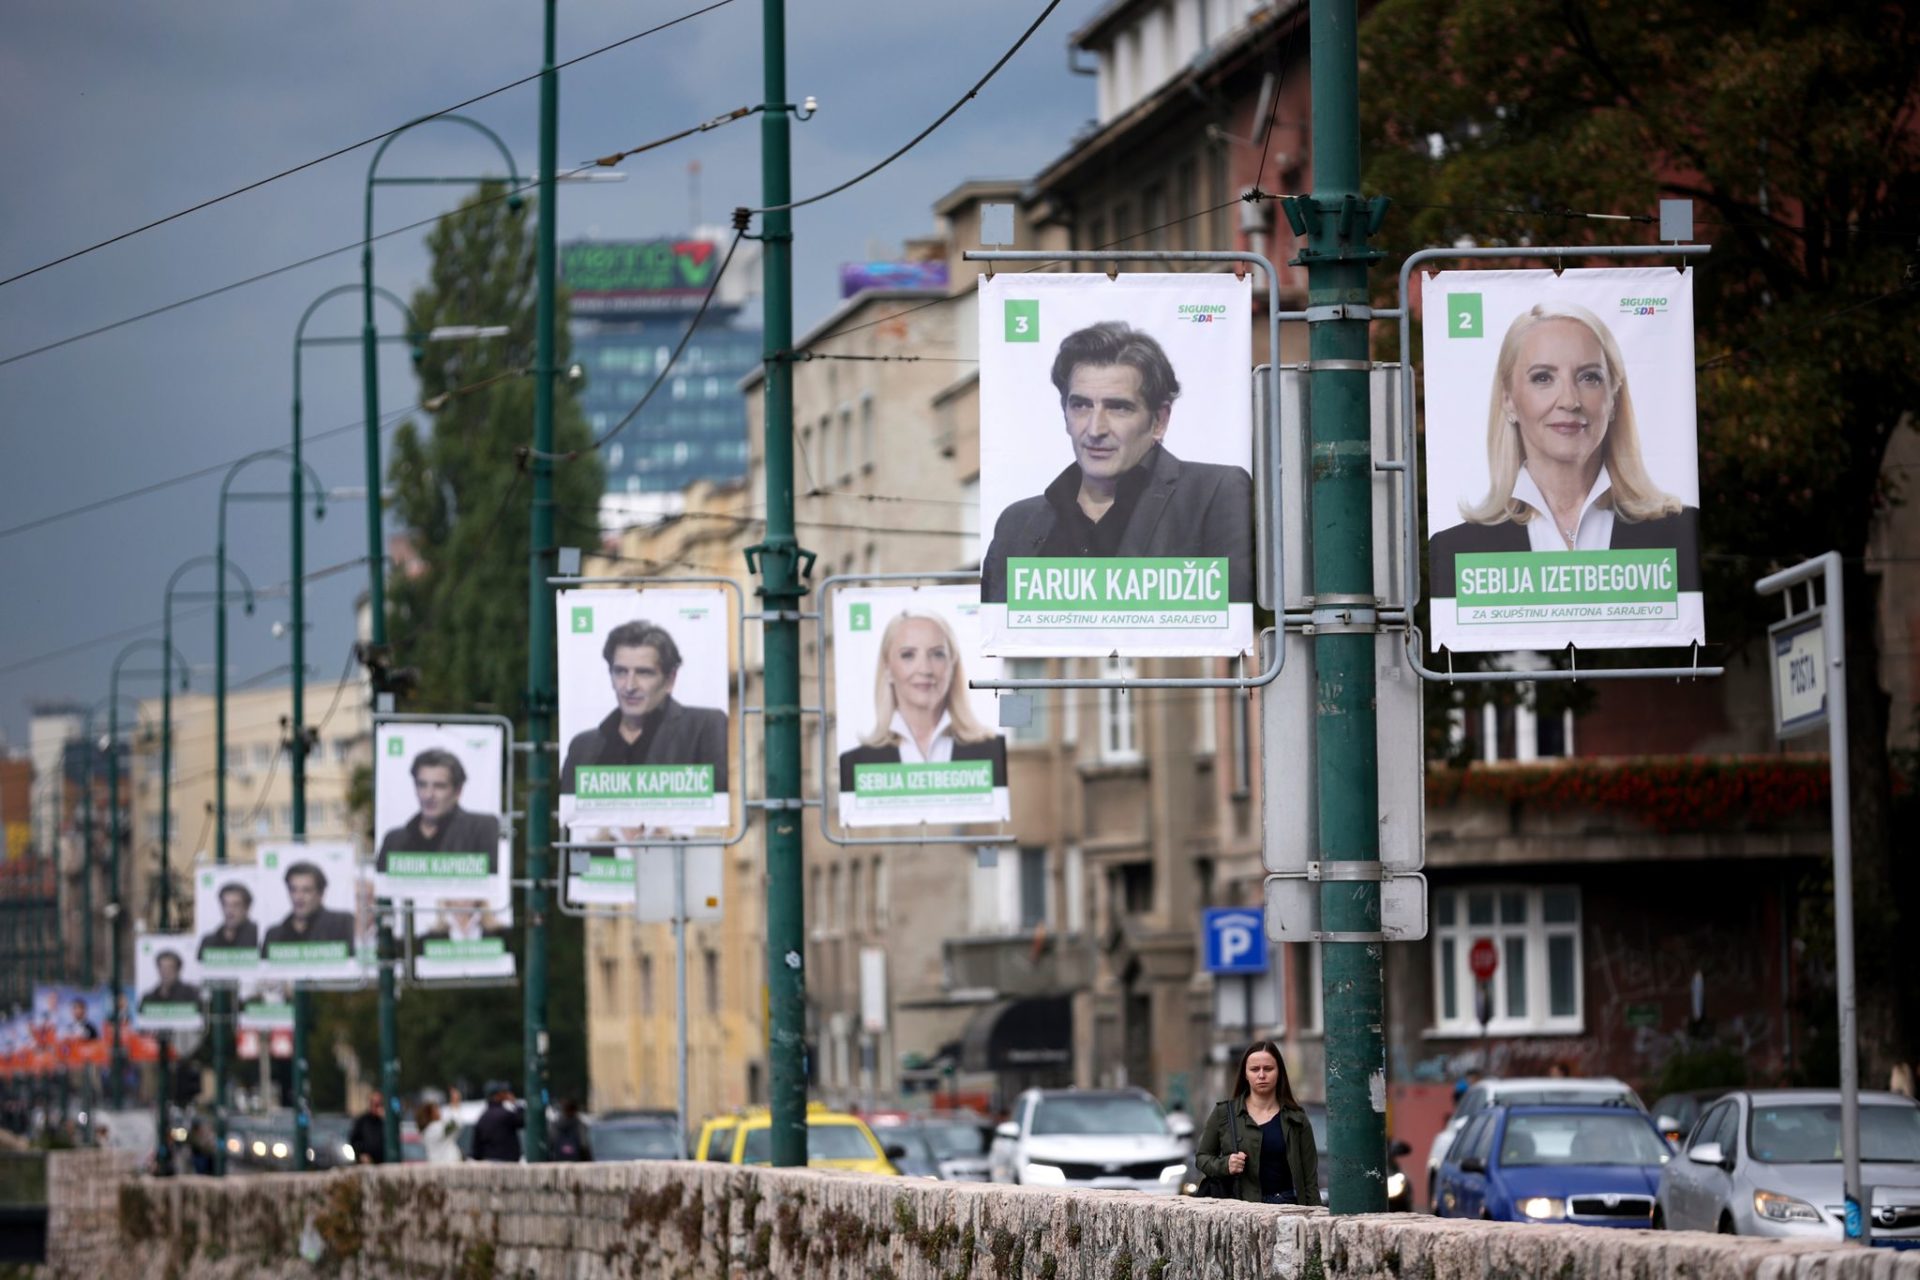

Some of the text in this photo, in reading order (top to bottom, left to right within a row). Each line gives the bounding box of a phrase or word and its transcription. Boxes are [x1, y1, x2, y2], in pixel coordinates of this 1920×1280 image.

[1177, 304, 1226, 314] SIGURNO
[1620, 297, 1668, 307] SIGURNO
[1633, 306, 1655, 315] SDA
[1015, 316, 1029, 333] 3
[1191, 314, 1212, 323] SDA
[1458, 312, 1472, 329] 2
[1014, 561, 1221, 600] FARUK KAPIDŽIĆ
[1461, 558, 1672, 595] SEBIJA IZETBEGOVIĆ
[1017, 612, 1218, 624] ZA SKUPŠTINU KANTONA SARAJEVO
[1472, 606, 1663, 619] ZA SKUPŠTINU KANTONA SARAJEVO
[580, 766, 709, 793] FARUK KAPIDŽIĆ
[1221, 927, 1251, 966] P
